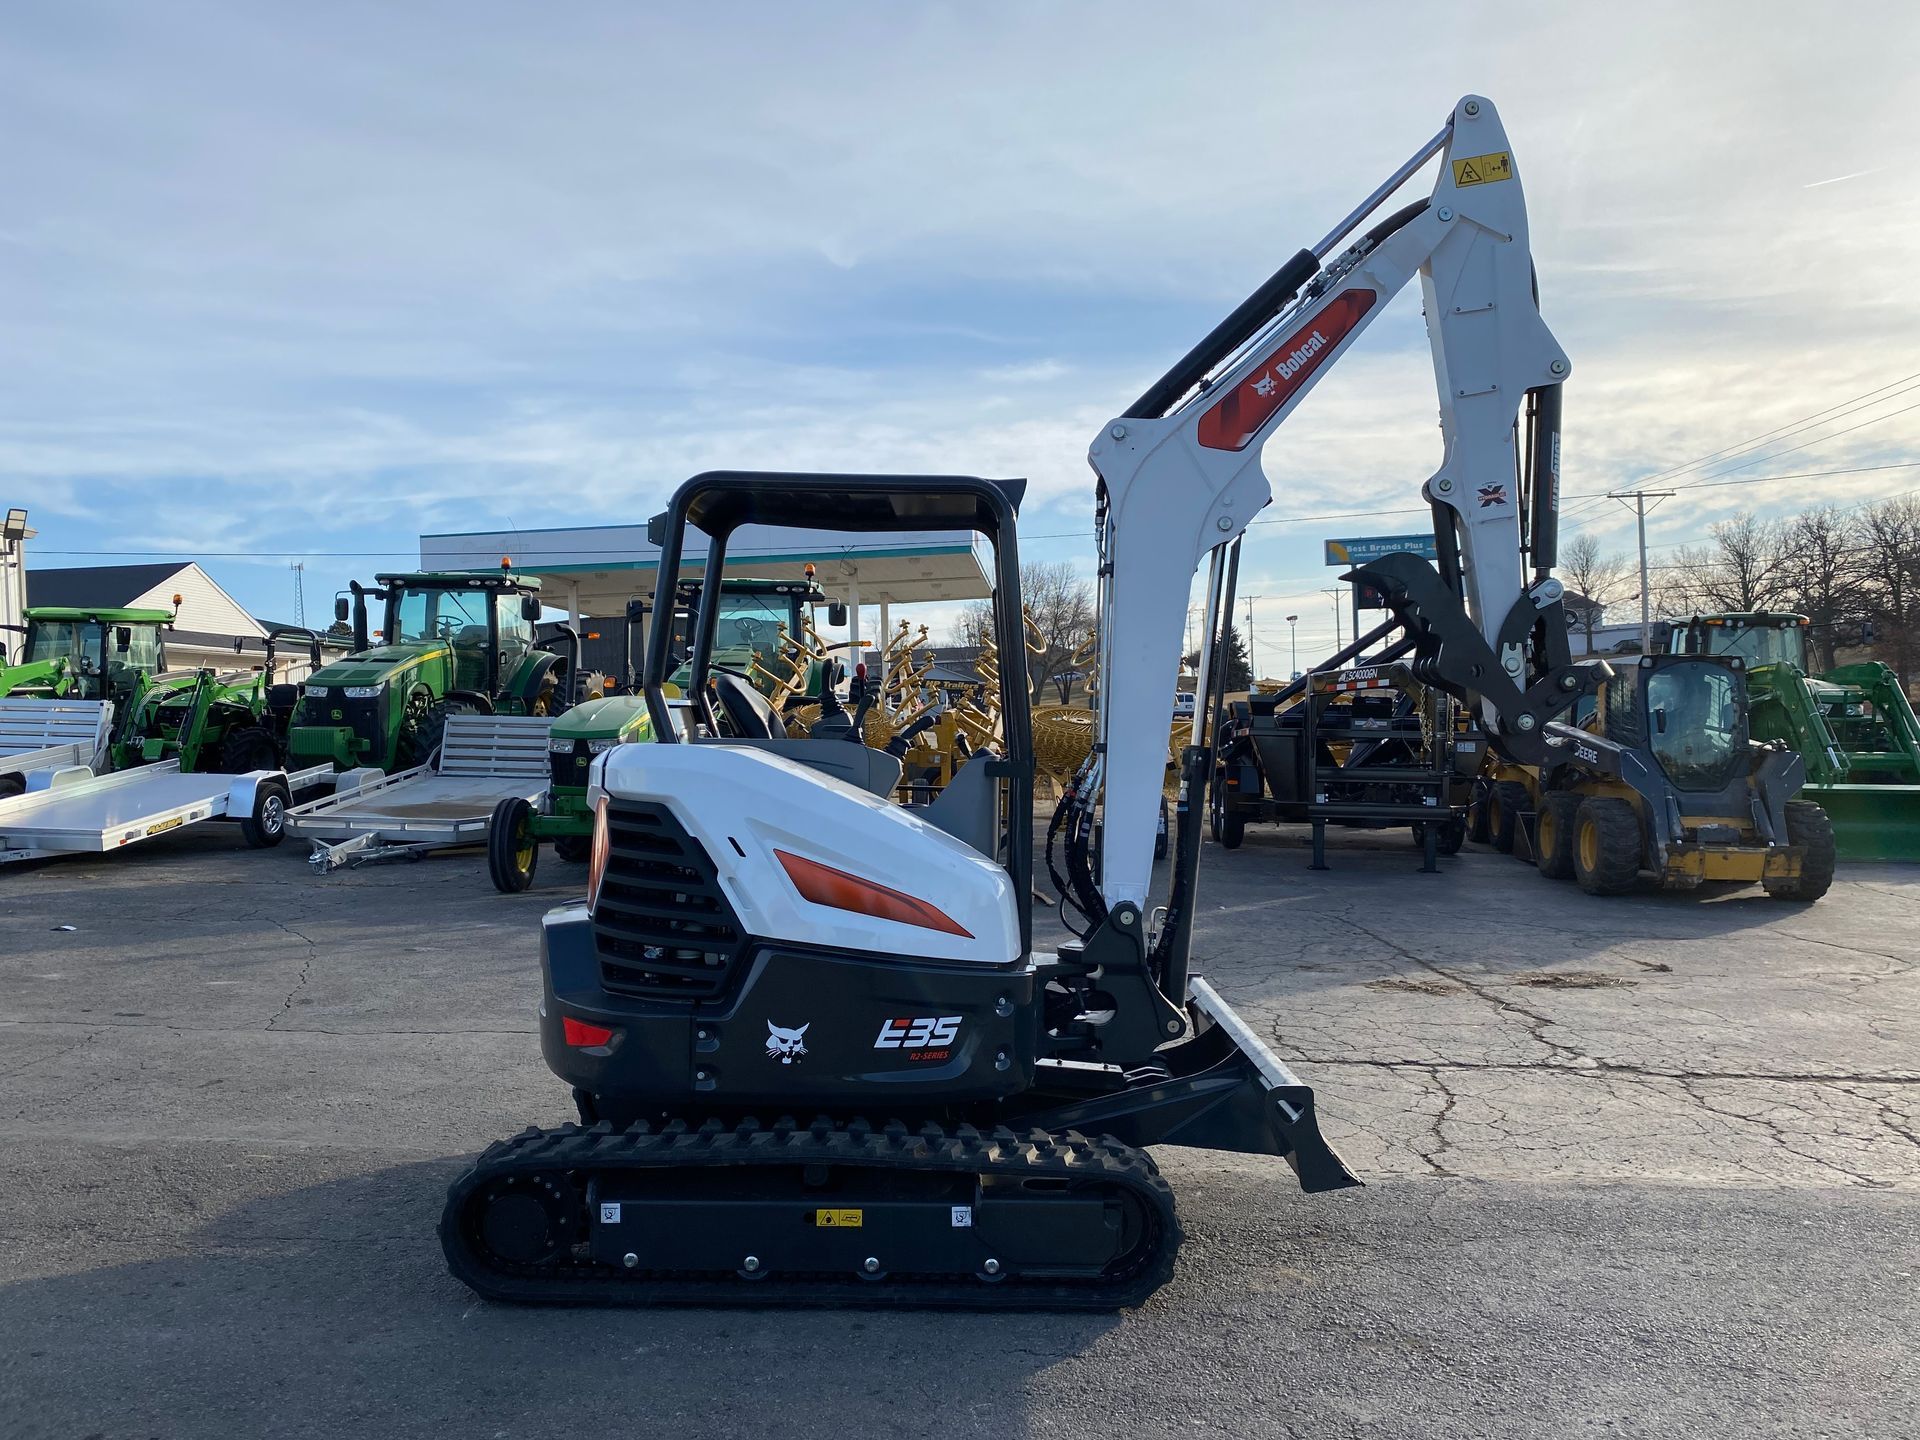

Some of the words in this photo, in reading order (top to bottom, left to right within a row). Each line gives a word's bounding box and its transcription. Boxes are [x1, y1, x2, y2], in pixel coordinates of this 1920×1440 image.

[1275, 330, 1327, 380] Bobcat
[1346, 545, 1366, 553] Best
[1369, 543, 1402, 552] Brands
[1404, 542, 1424, 550] Plus
[943, 681, 980, 690] Trailers
[873, 1016, 963, 1049] E35
[909, 1050, 950, 1061] R2-SERIES
